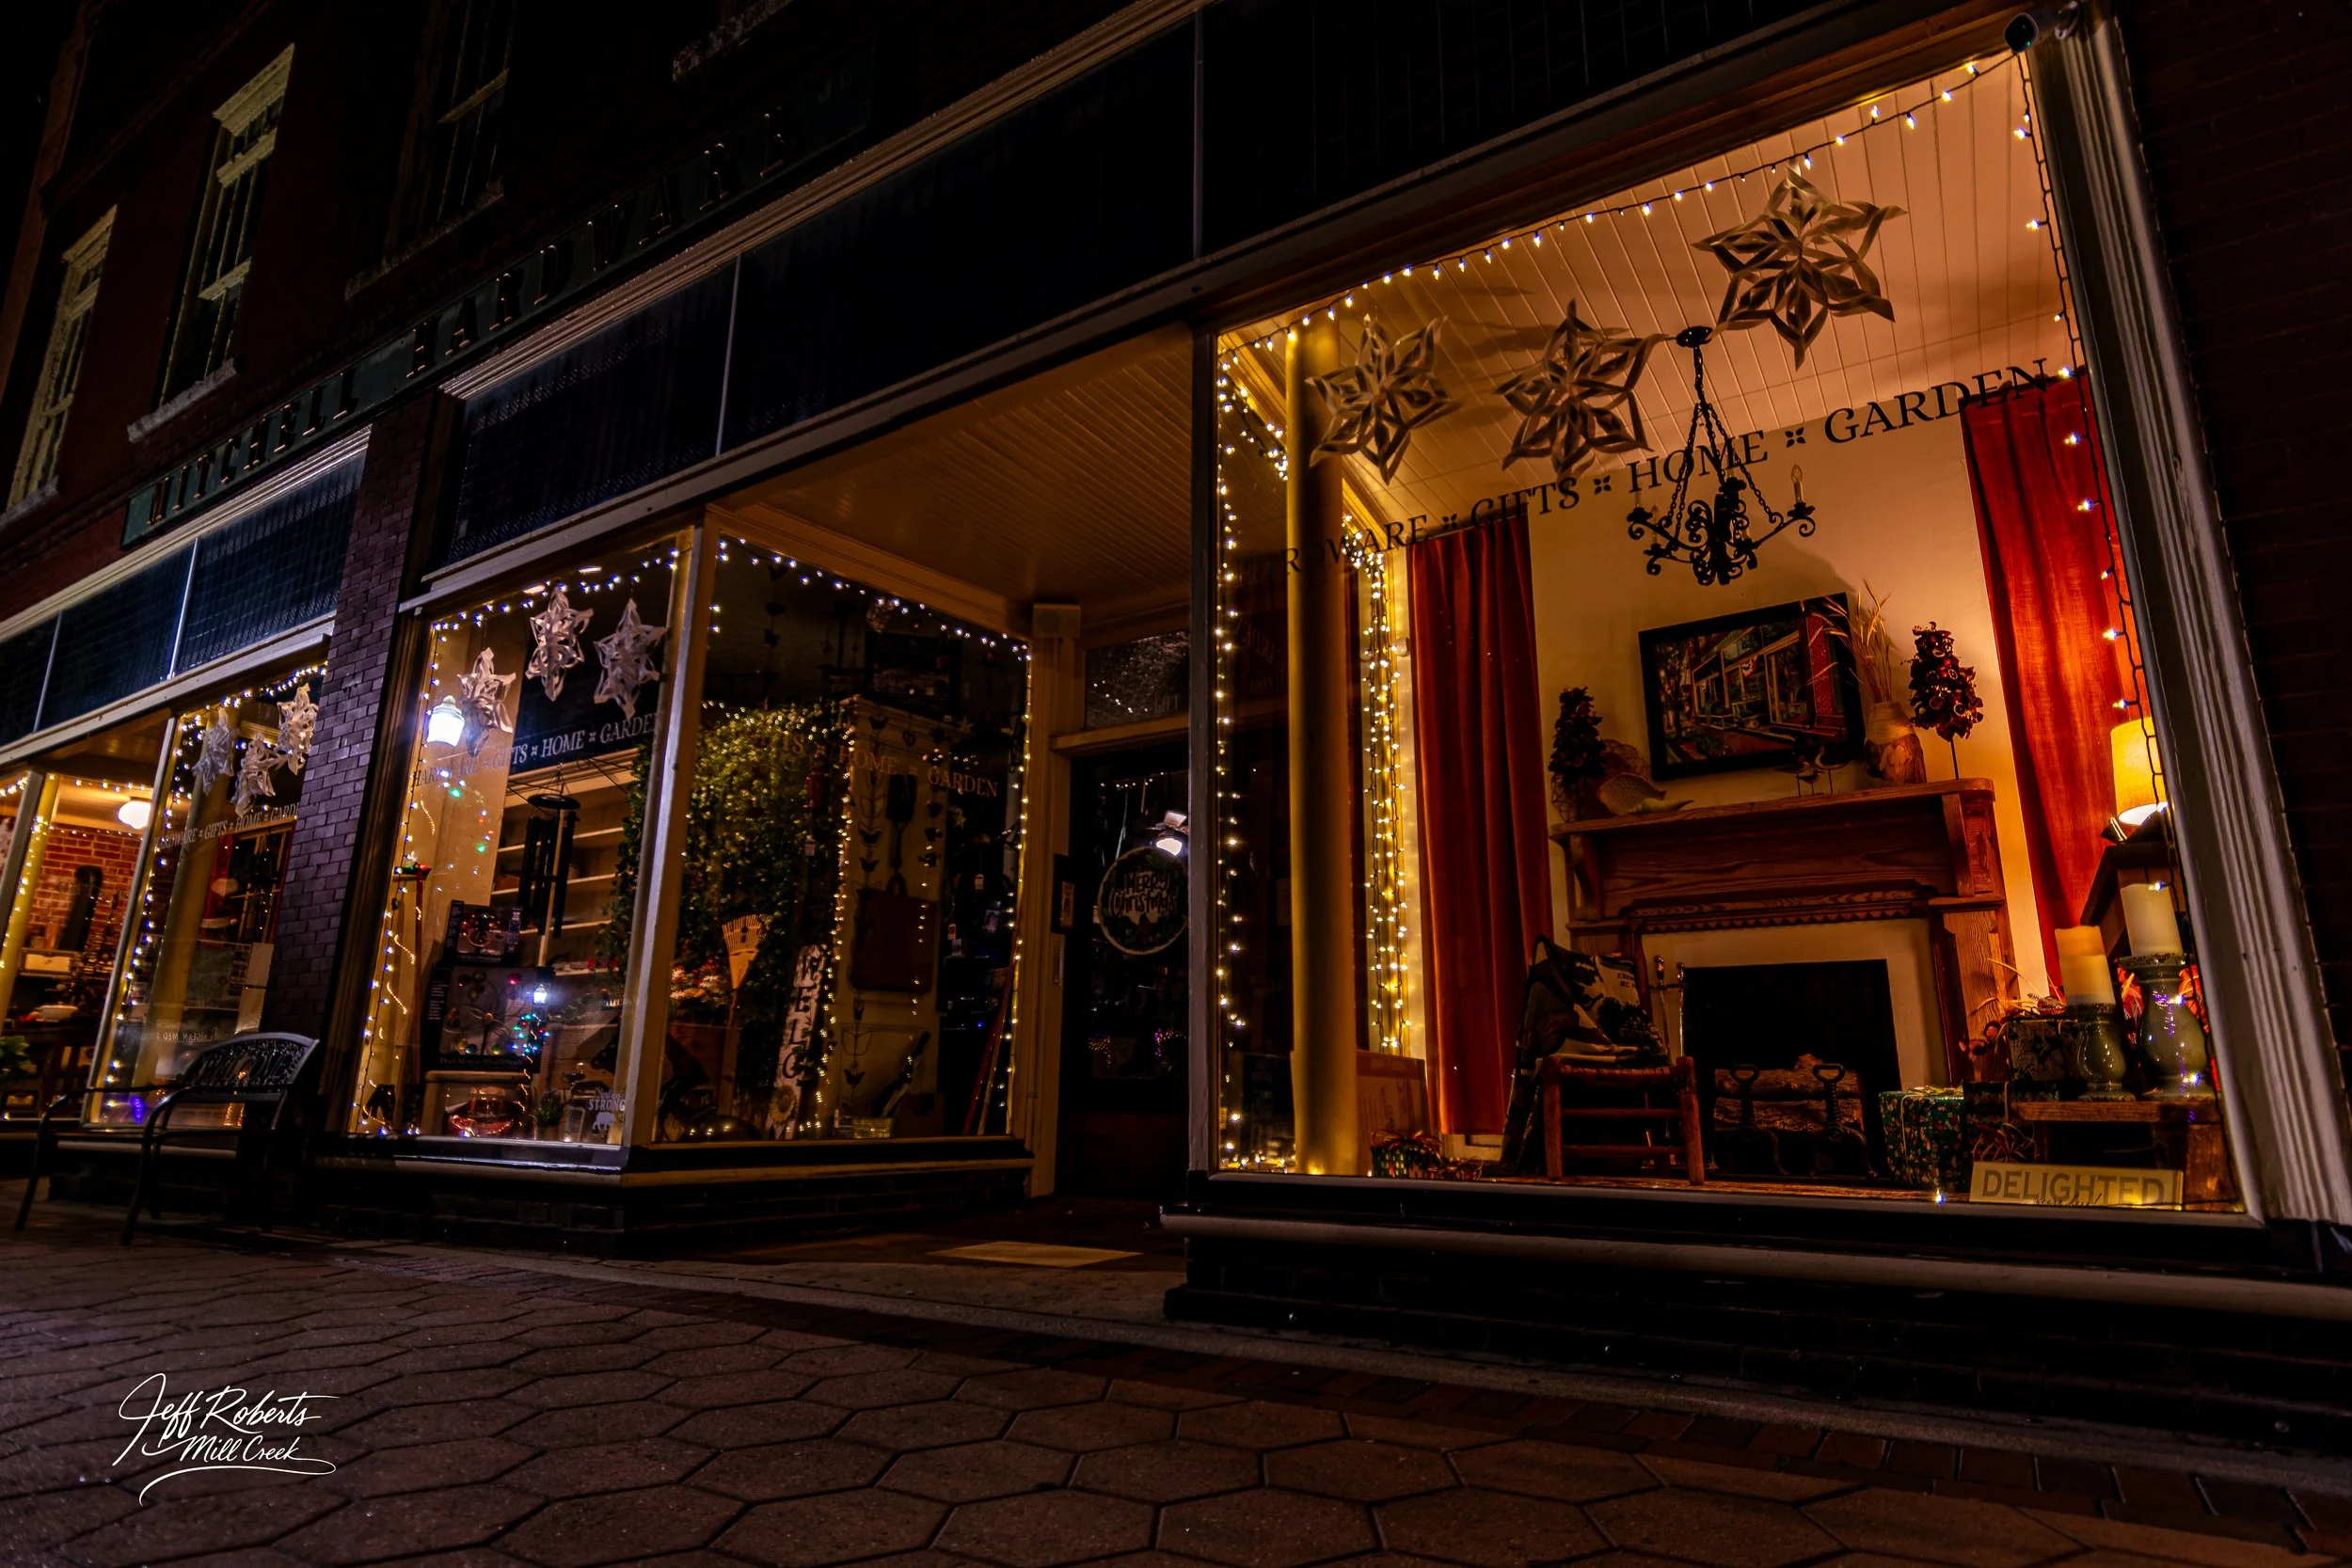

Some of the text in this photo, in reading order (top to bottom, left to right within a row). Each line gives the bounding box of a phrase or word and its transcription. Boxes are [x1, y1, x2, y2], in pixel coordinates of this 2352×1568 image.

[145, 103, 793, 525] MITCHELL HARDWARE
[1470, 477, 1580, 530] GIFTS
[1628, 430, 1769, 494] HOME
[1824, 357, 2048, 444] GARDEN
[541, 729, 585, 759] HOME
[599, 712, 656, 744] GARDE
[928, 765, 999, 799] GARDEN
[204, 820, 227, 840] GIFTS
[235, 811, 262, 830] HOME
[270, 802, 300, 821] GARD
[587, 1098, 627, 1112] STRONG
[1982, 1169, 2164, 1206] DELIGHTED
